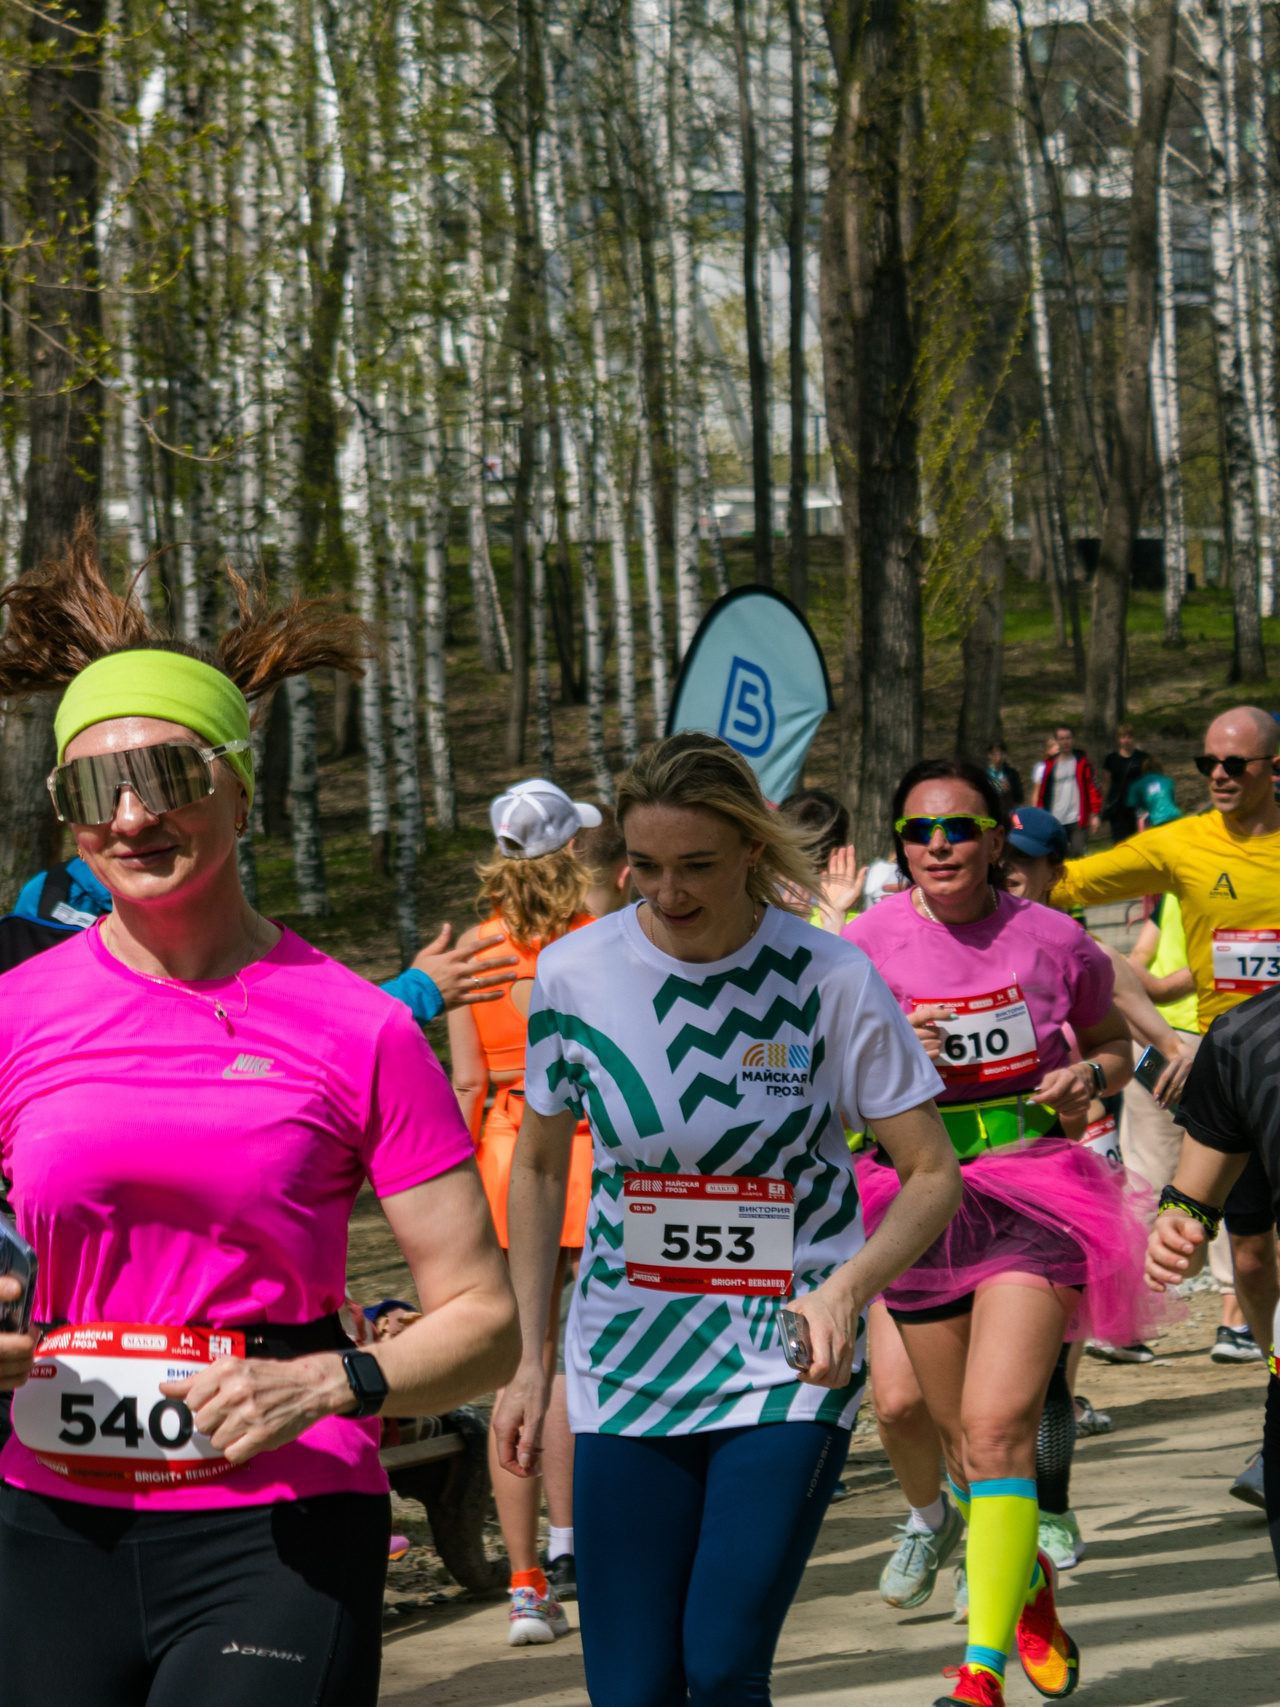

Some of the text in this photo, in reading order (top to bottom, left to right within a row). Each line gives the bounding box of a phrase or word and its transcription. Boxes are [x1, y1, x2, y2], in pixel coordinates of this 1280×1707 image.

[1237, 956, 1280, 978] 173
[944, 1028, 1010, 1061] 610
[232, 1053, 275, 1073] NIKE
[742, 1069, 808, 1084] МАЙСКАЯ
[766, 1085, 805, 1098] ГРОЗА
[665, 1180, 699, 1188] МАЙСКАЯ
[739, 1205, 790, 1214] ВИКТОРИЯ
[661, 1224, 755, 1263] 553
[711, 1278, 741, 1286] BRIGHT
[73, 1329, 113, 1341] МАЙСКАЯ
[71, 1340, 98, 1349] ГРОЗА
[58, 1394, 194, 1449] 540
[135, 1470, 176, 1482] BRIGHT
[241, 1647, 305, 1662] DEMIX
